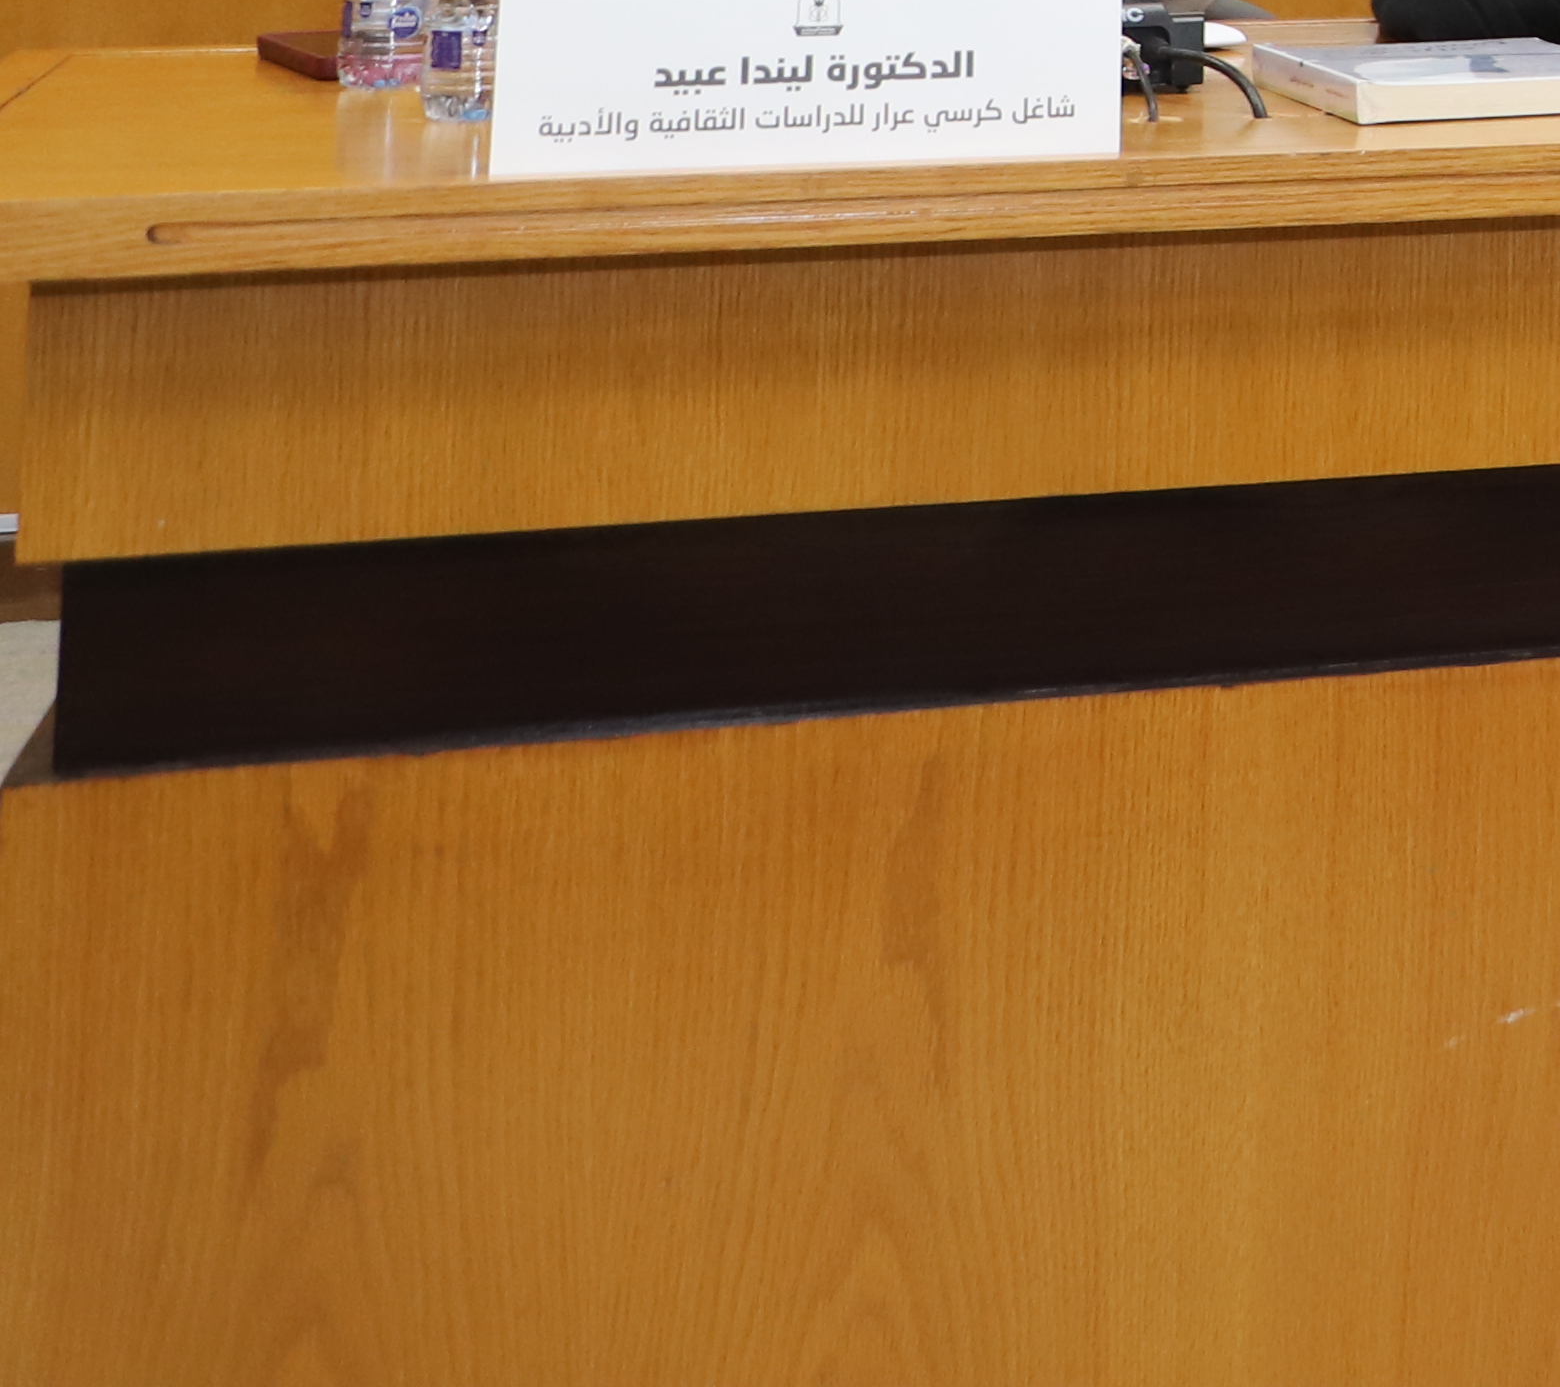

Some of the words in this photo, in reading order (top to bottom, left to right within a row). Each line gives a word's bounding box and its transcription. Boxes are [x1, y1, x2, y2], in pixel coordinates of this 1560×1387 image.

[653, 63, 728, 96] عبيد
[738, 53, 815, 94] ليندا
[826, 49, 976, 91] الدكتورة
[537, 107, 641, 144] والأدبية
[648, 106, 747, 141] الثقافية
[753, 101, 866, 135] للدراسات
[871, 101, 916, 133] عرار
[922, 98, 1004, 134] كرسي
[1011, 95, 1077, 125] شاغل
